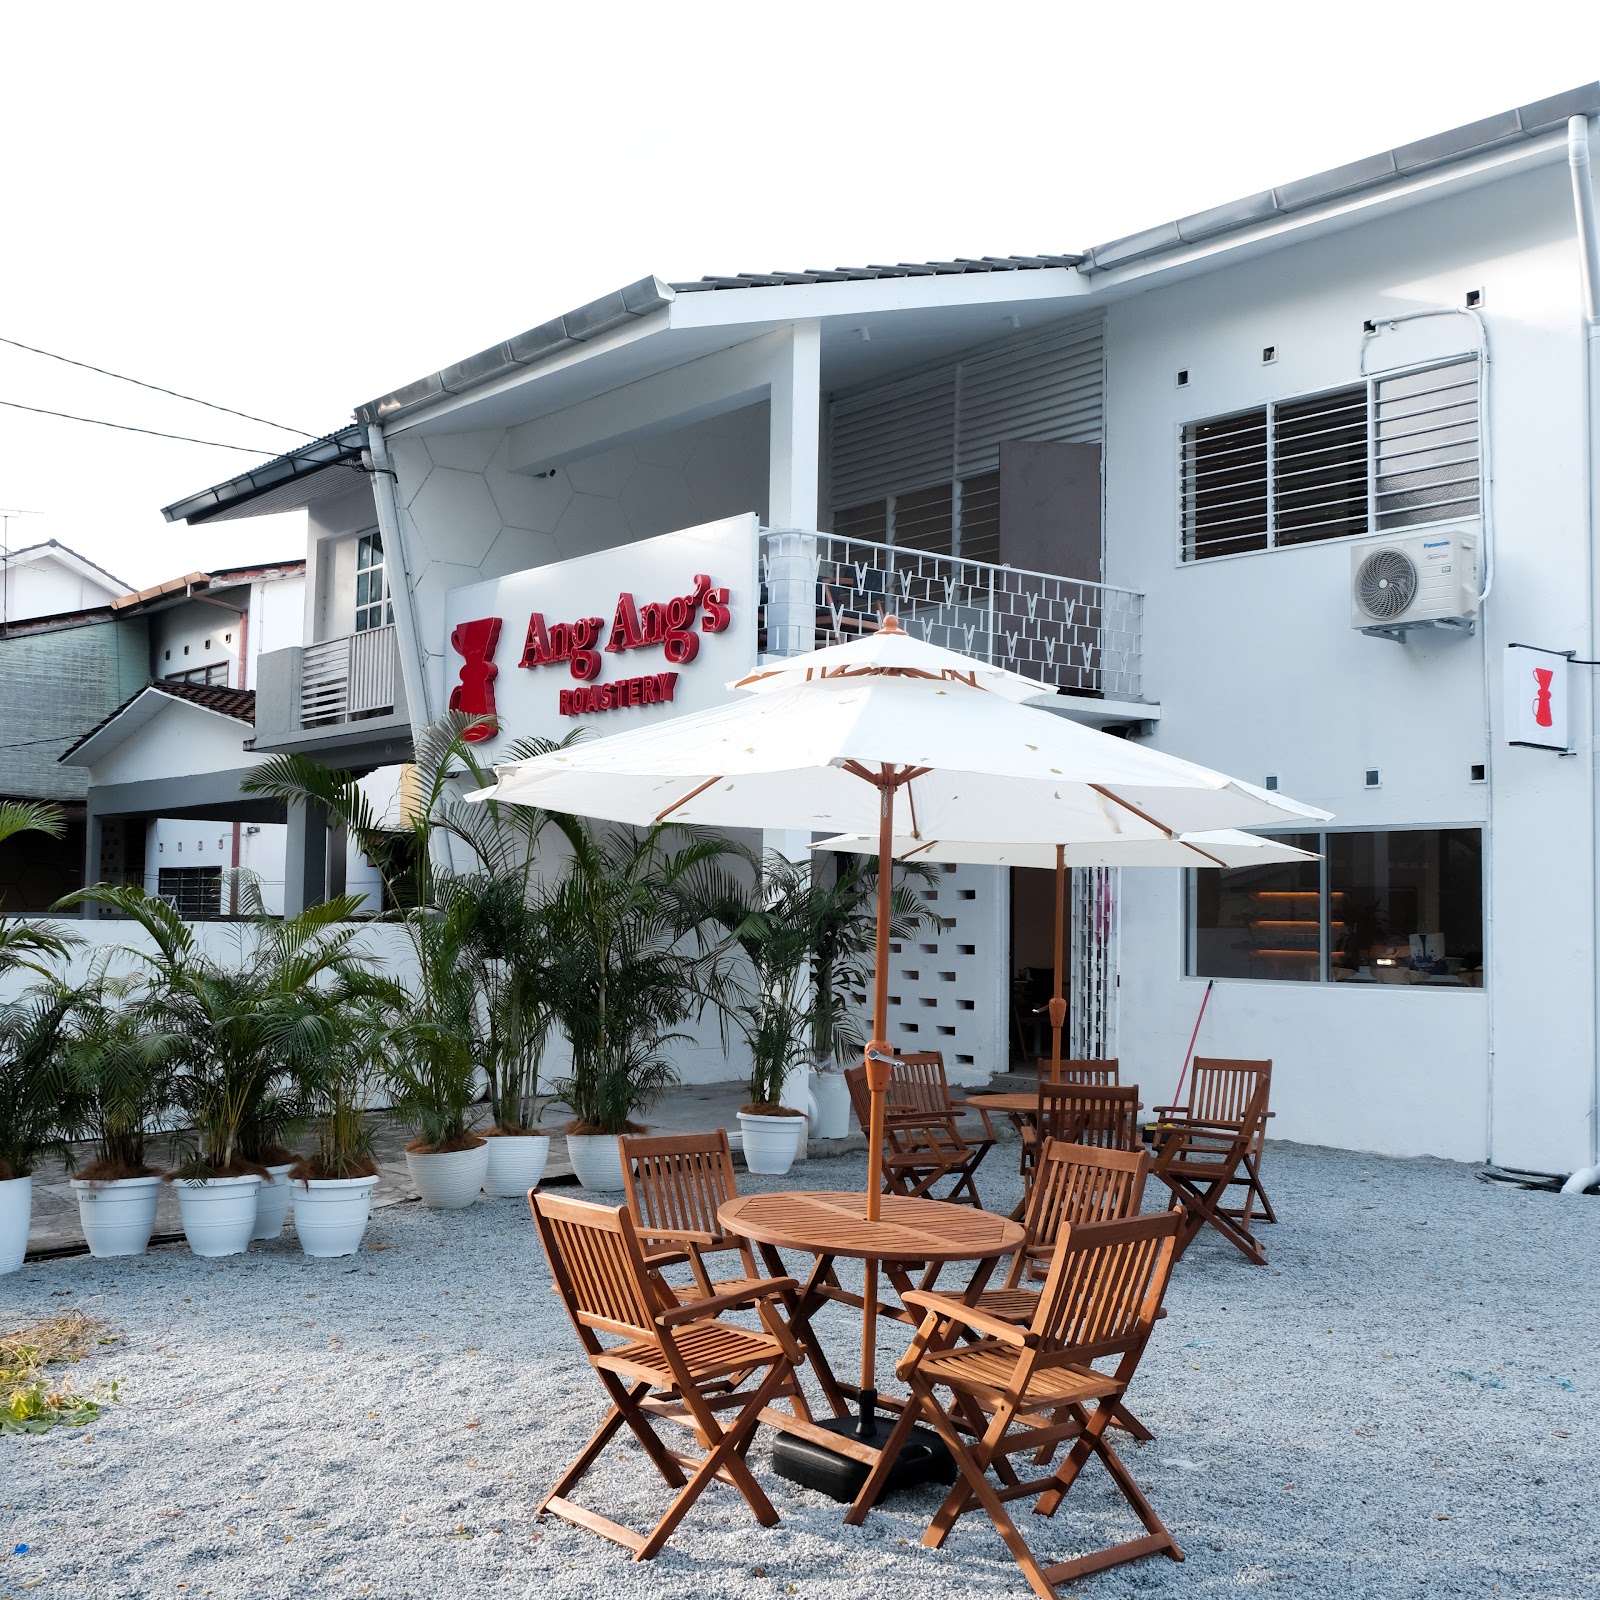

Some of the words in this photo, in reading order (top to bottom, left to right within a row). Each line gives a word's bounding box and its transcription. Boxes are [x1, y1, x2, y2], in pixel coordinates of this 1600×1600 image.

[518, 612, 604, 681] Ang
[605, 573, 731, 664] Ang's
[559, 672, 679, 716] ROASTERY
